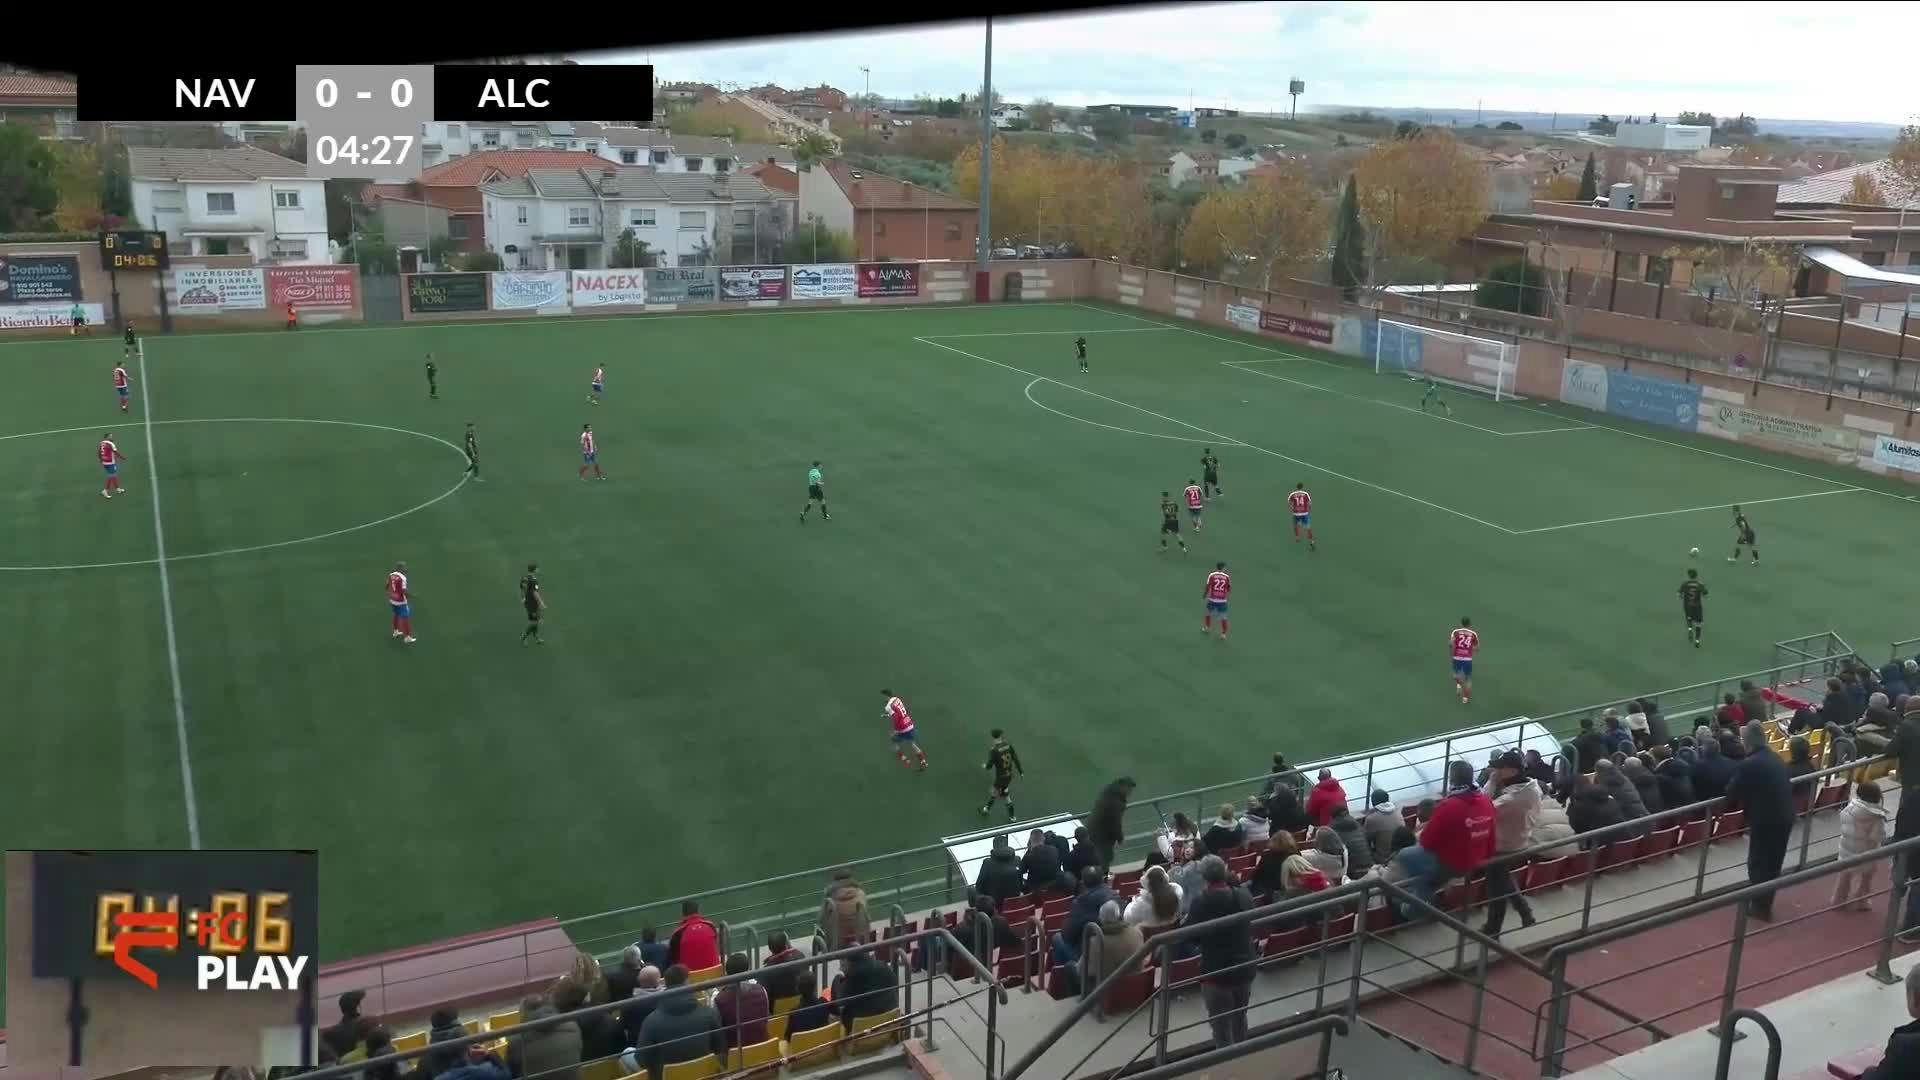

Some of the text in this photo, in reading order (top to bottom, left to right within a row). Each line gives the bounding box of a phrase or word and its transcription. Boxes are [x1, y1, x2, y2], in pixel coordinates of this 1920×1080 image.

[105, 237, 113, 249] 0
[9, 264, 67, 276] Domino's
[656, 270, 705, 281] Del Real
[576, 274, 639, 291] NACEX
[598, 294, 607, 302] by
[0, 316, 48, 328] Ricardo
[1214, 579, 1226, 591] 22
[1458, 634, 1472, 648] 24
